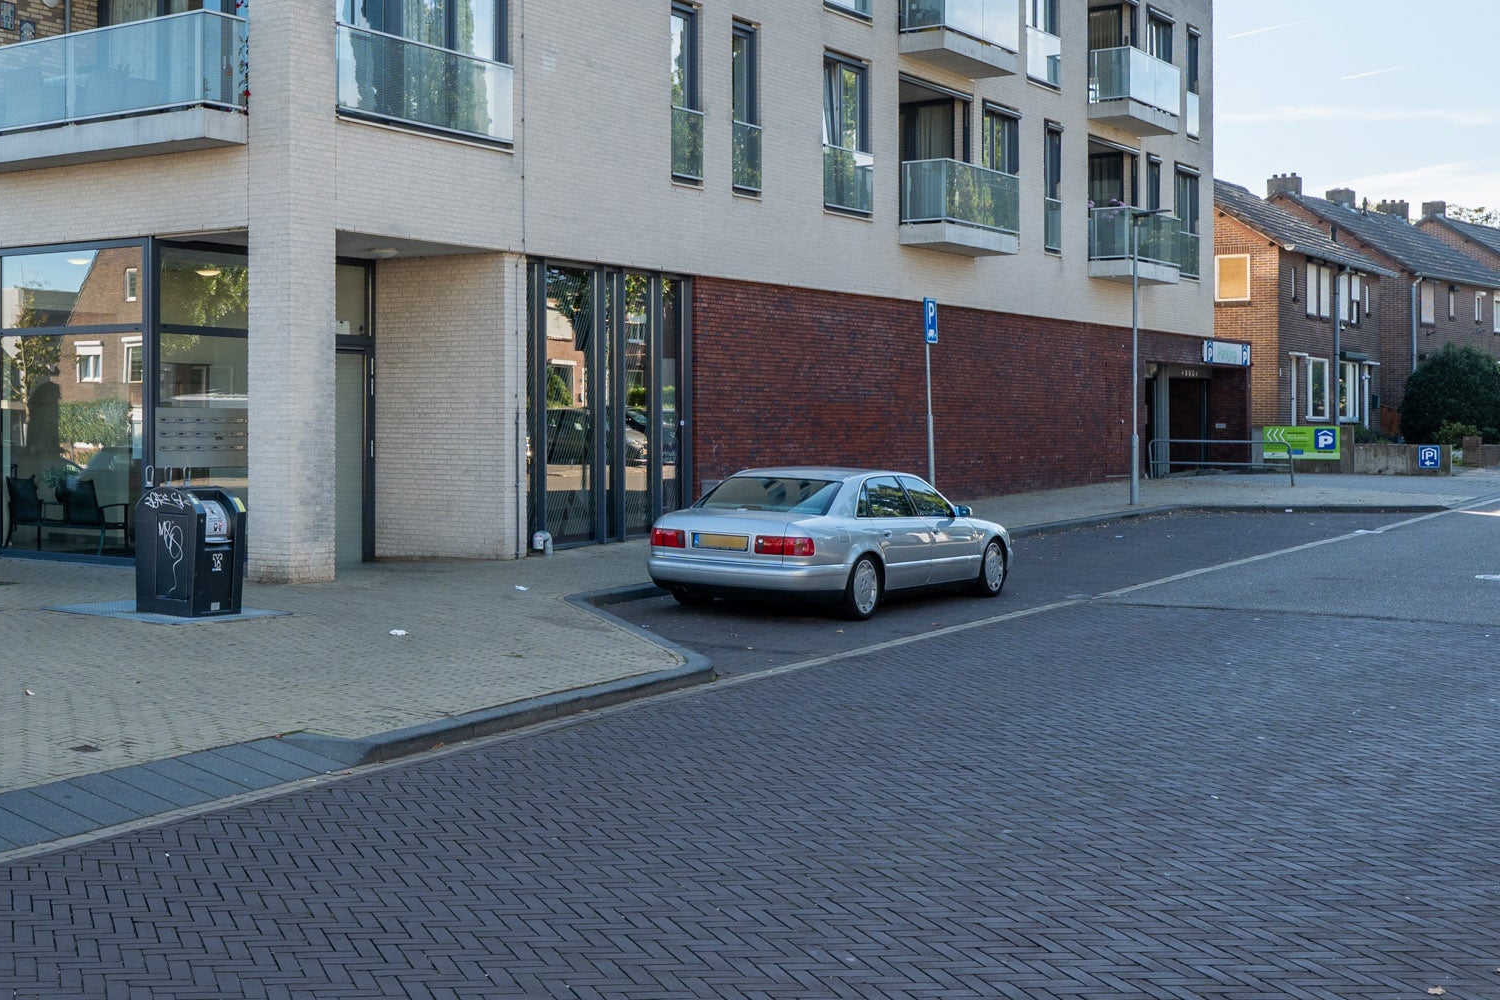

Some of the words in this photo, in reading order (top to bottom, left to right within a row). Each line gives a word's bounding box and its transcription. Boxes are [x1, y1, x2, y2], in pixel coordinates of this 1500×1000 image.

[928, 302, 935, 325] P
[1318, 435, 1334, 448] P
[1425, 451, 1434, 460] P
